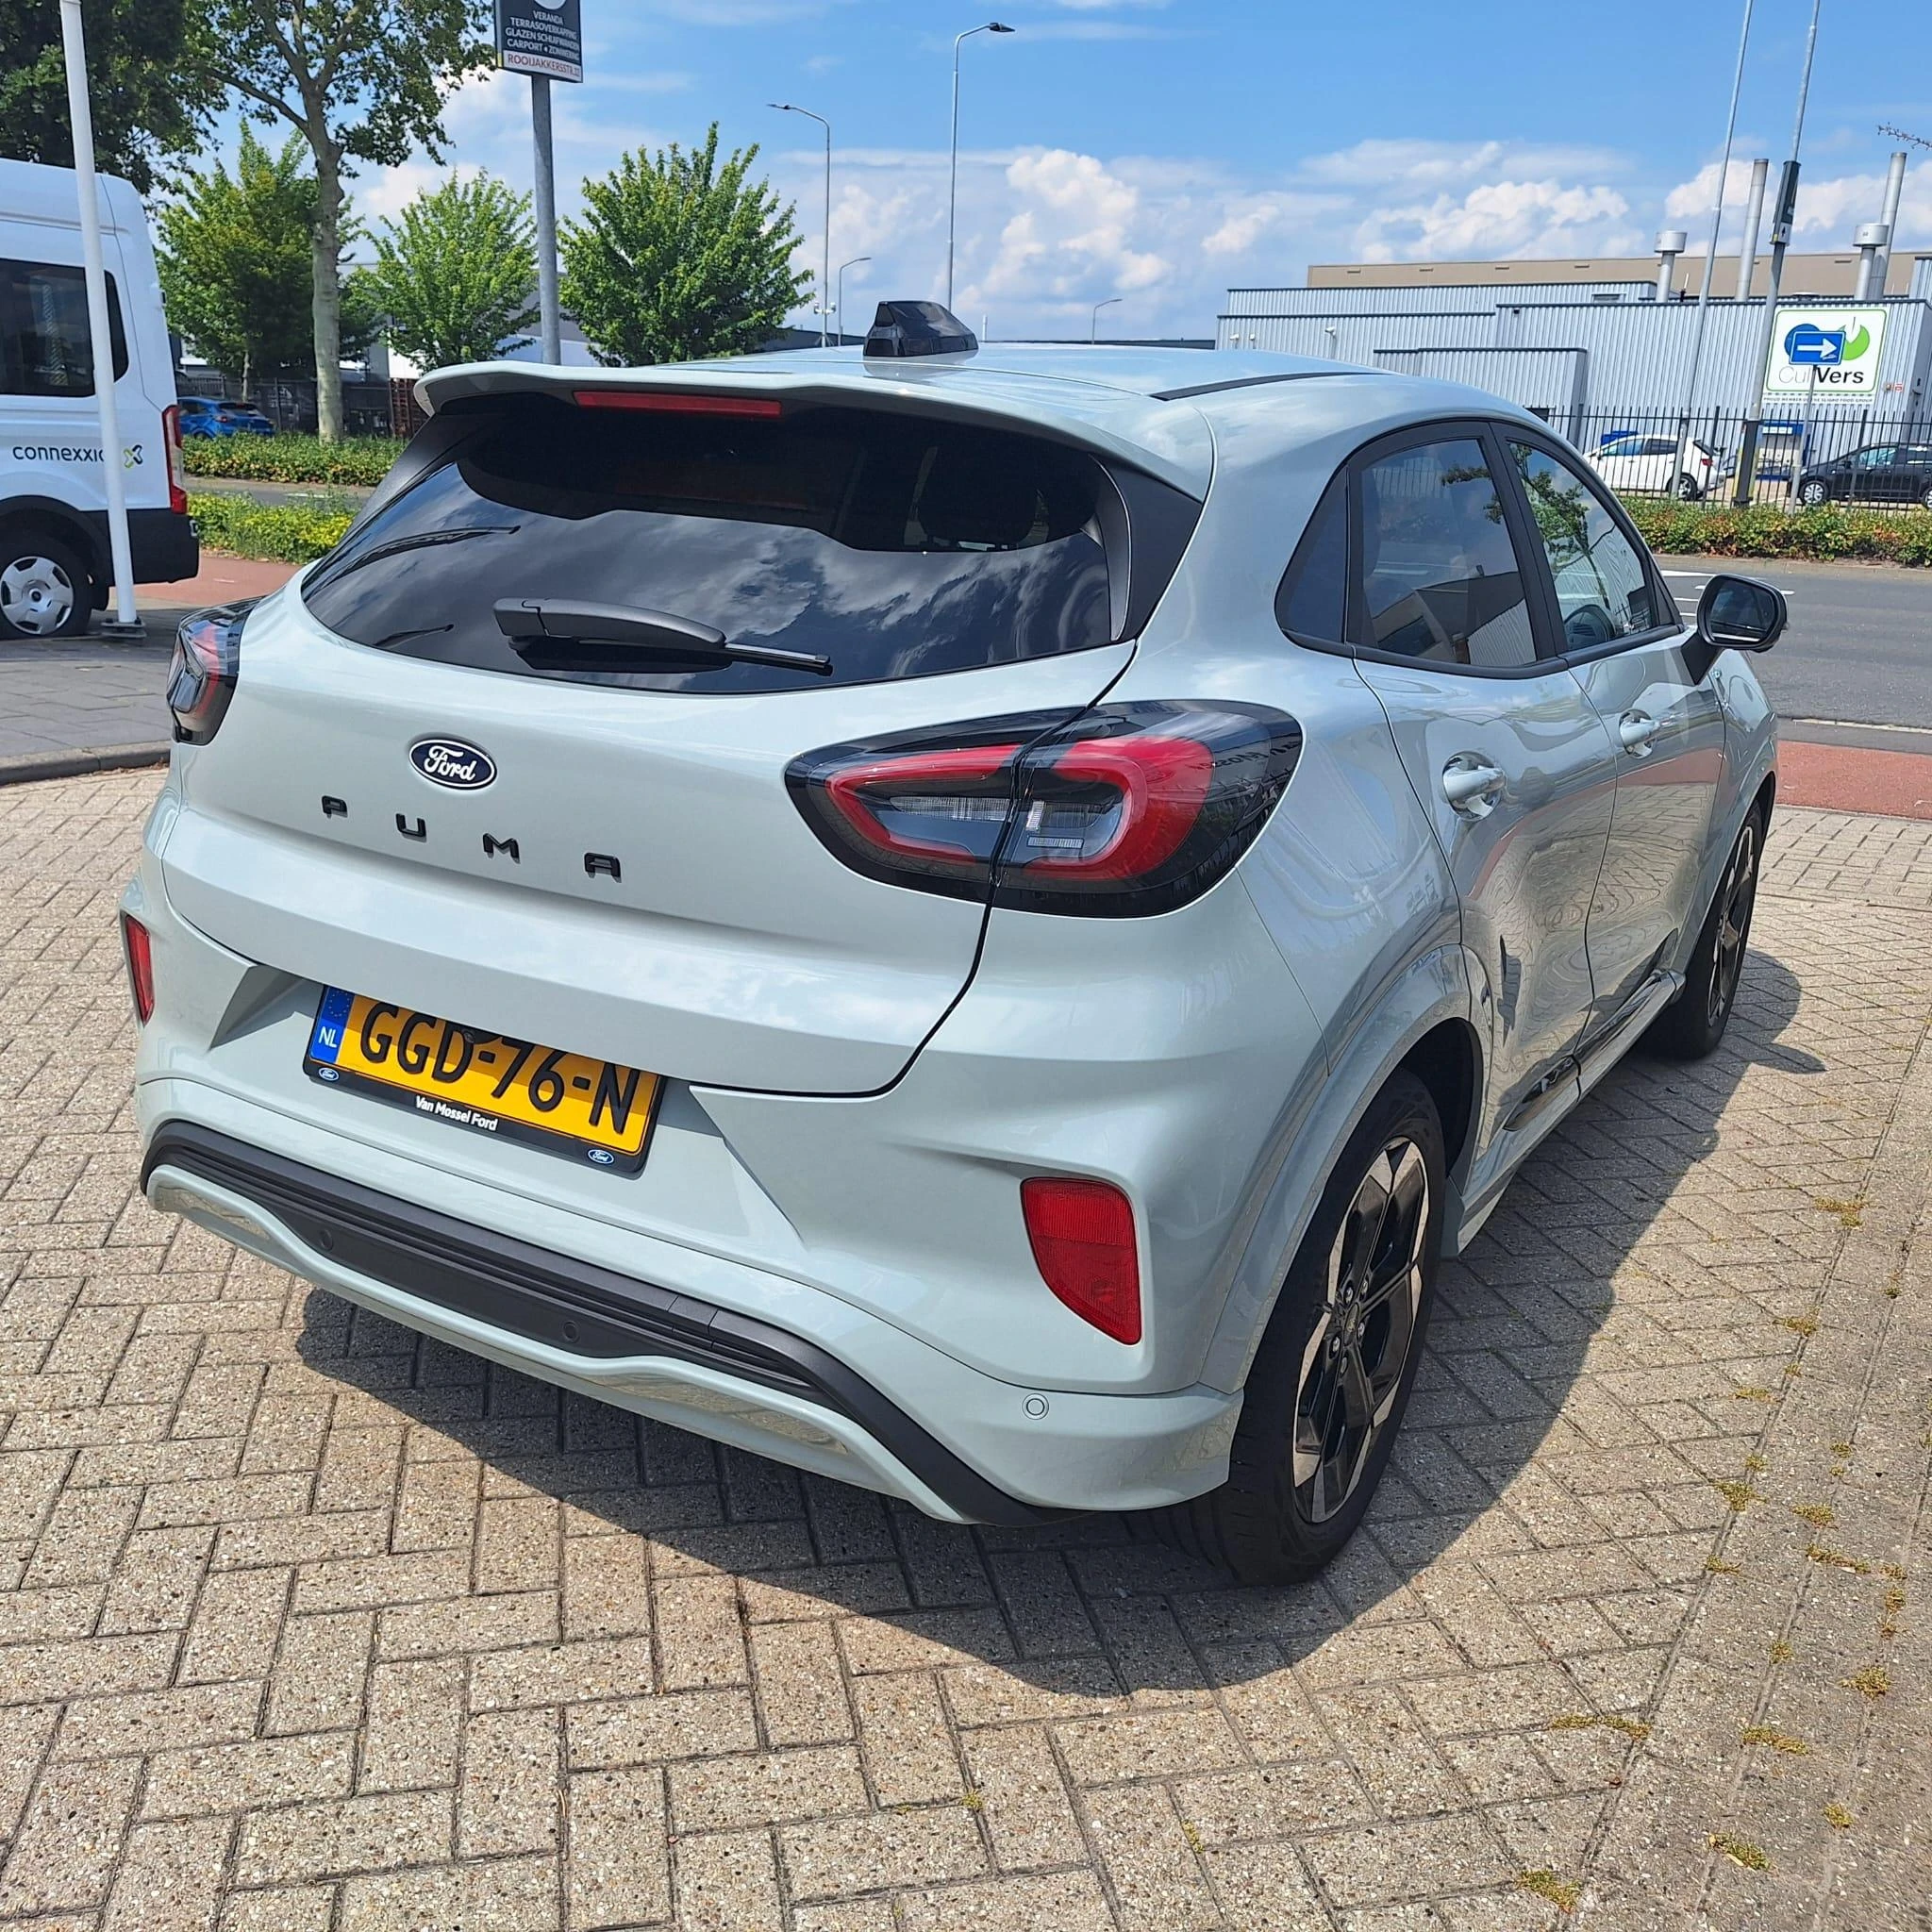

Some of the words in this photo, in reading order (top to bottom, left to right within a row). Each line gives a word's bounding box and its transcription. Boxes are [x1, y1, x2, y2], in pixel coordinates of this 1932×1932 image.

[533, 10, 564, 25] VERANDA
[505, 27, 537, 41] GLAZEN
[507, 39, 543, 52] CARPORT
[1778, 365, 1865, 384] CulVers
[424, 745, 476, 781] Ford
[322, 795, 622, 880] PUMA
[319, 1026, 338, 1050] NL
[359, 1001, 641, 1135] GGD-76-N
[416, 1095, 434, 1112] Van
[435, 1101, 472, 1124] Mossel
[471, 1112, 499, 1131] Ford
